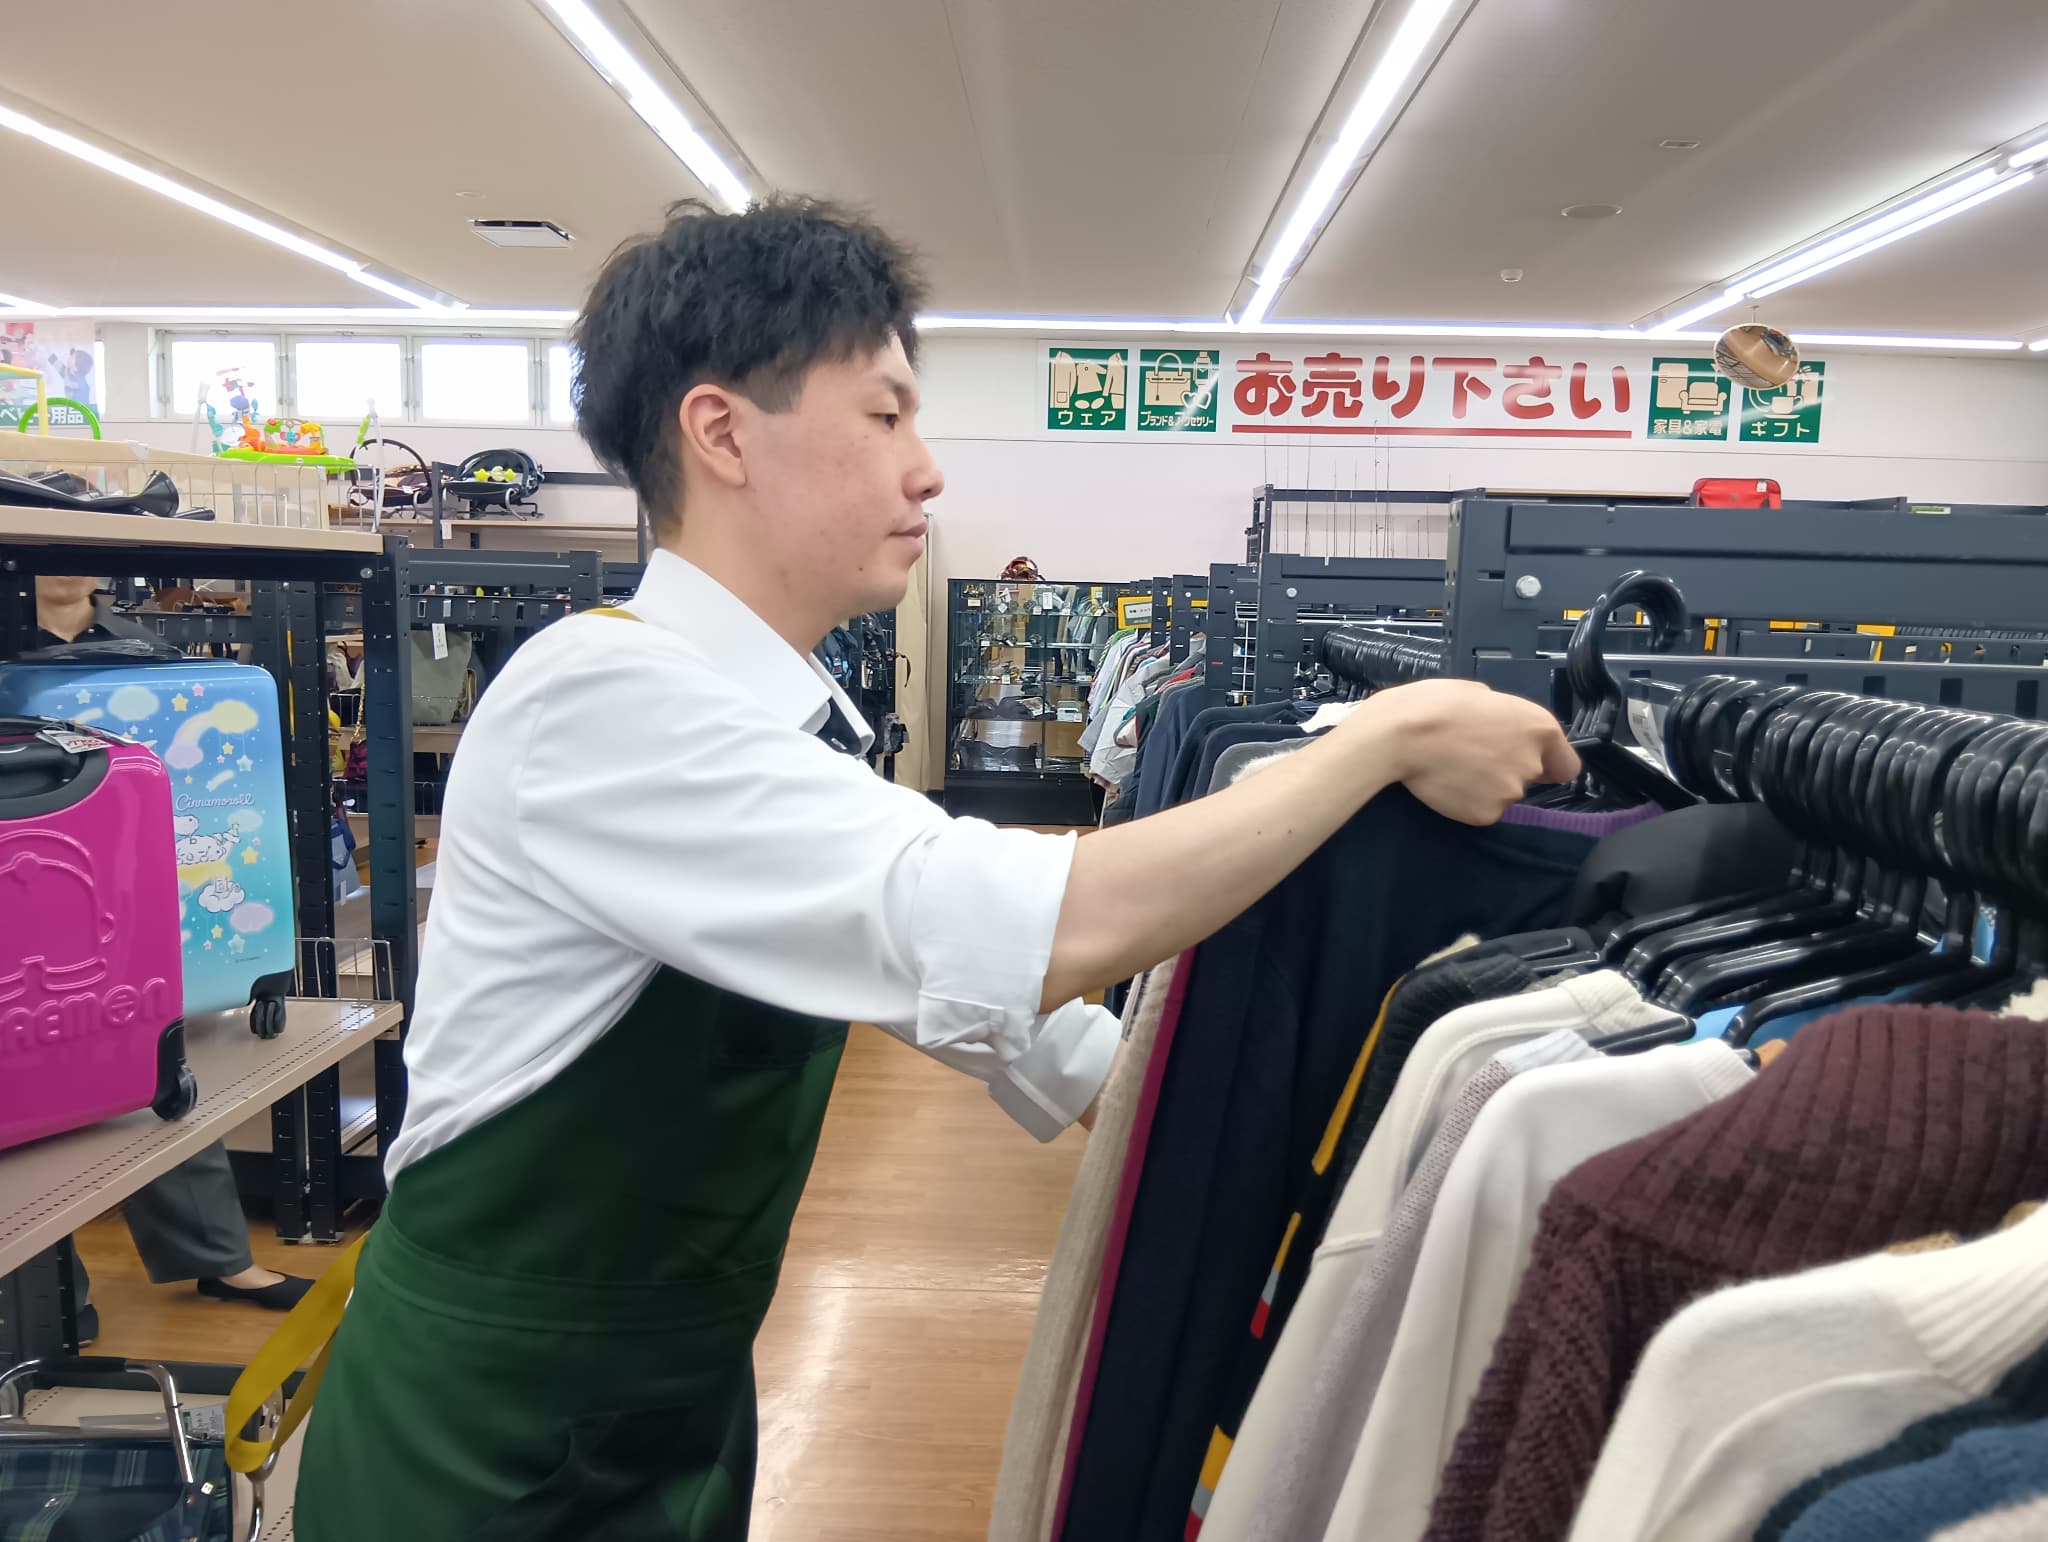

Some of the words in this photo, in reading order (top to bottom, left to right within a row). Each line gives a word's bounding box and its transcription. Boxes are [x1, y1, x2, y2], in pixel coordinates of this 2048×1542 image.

[1234, 352, 1630, 420] お売り下さい
[1058, 410, 1116, 426] ウェア
[1653, 419, 1722, 435] 家具&家電
[1751, 421, 1810, 438] ギフト
